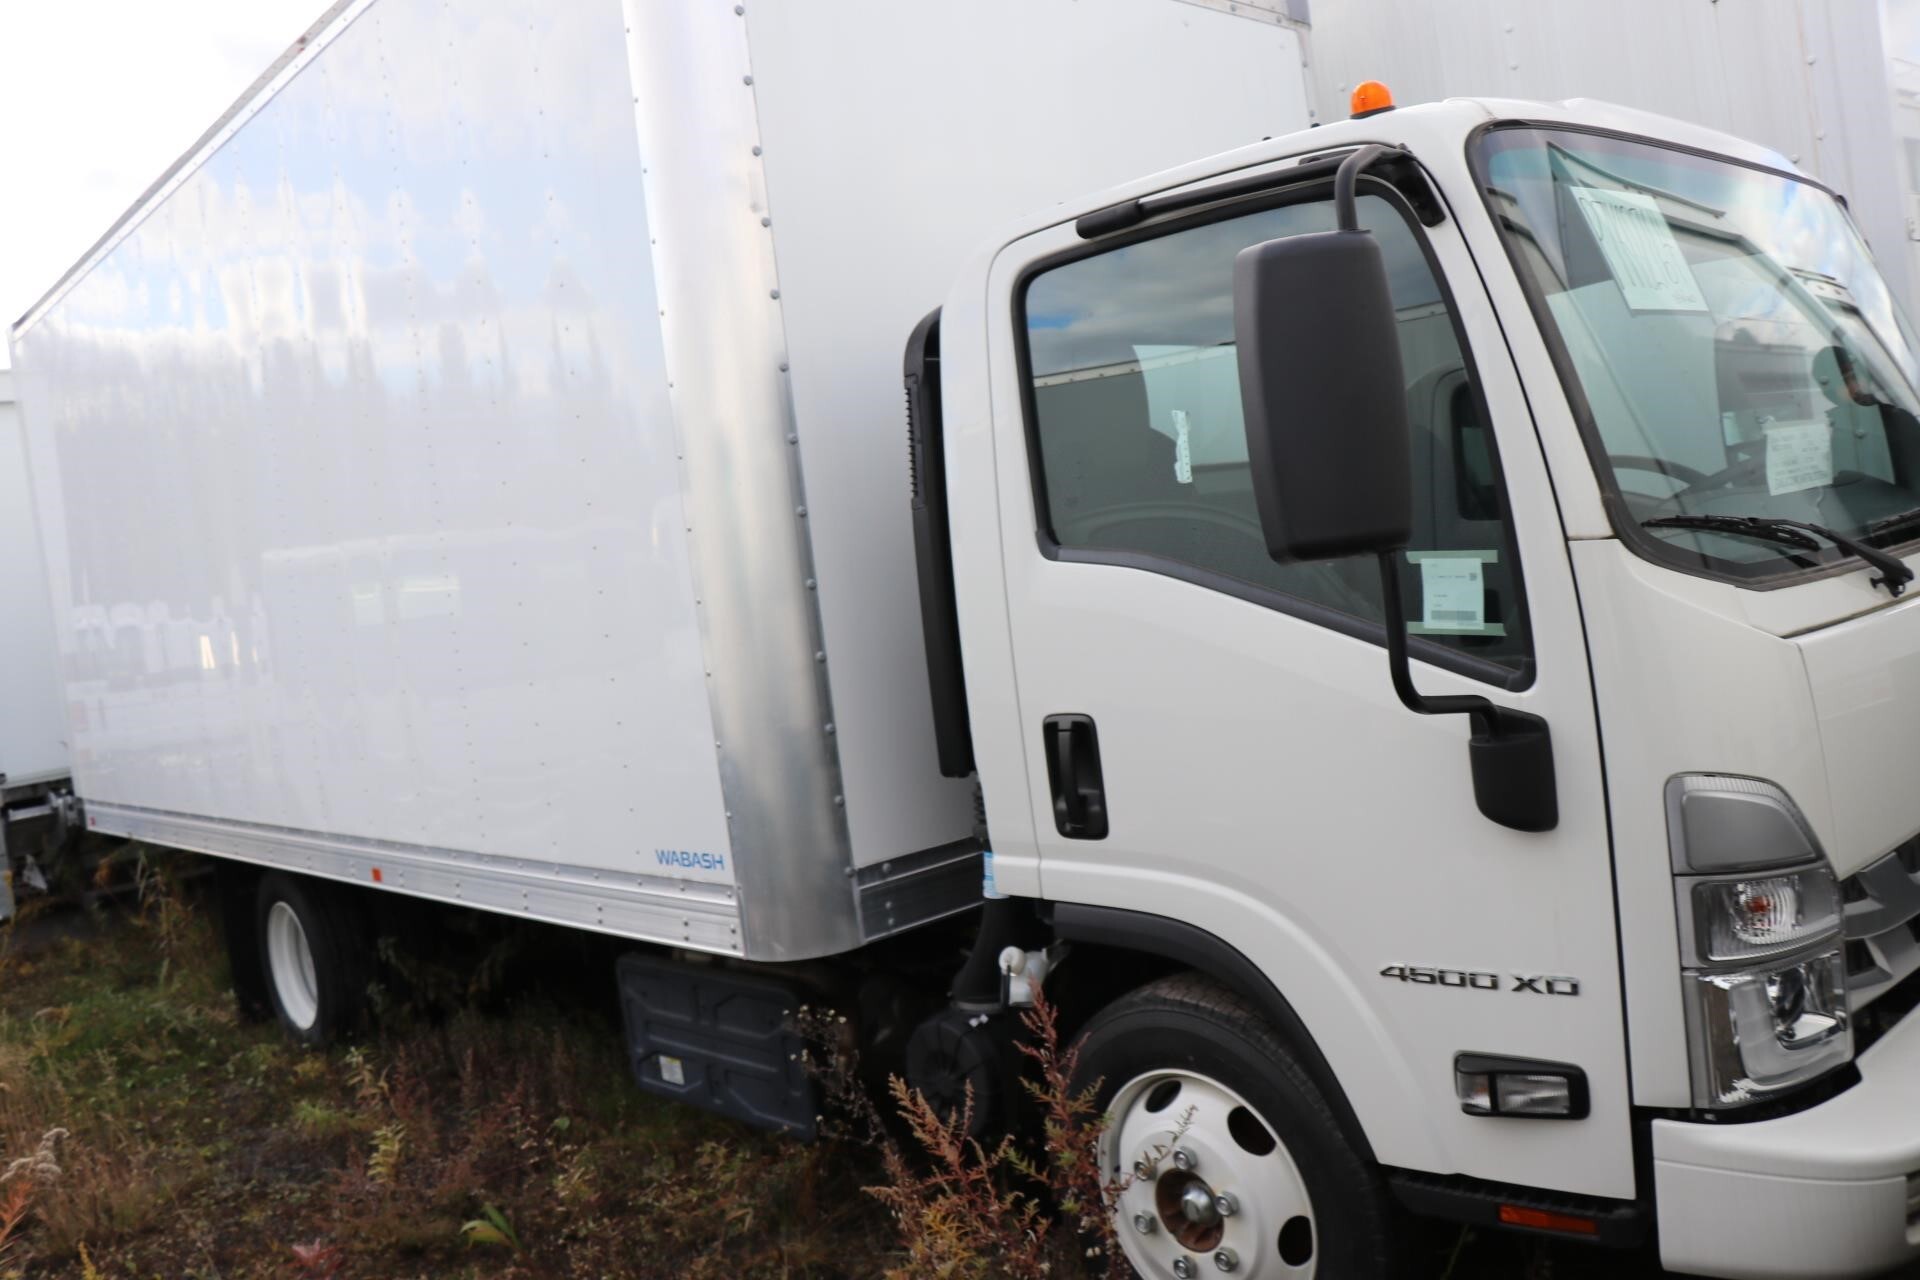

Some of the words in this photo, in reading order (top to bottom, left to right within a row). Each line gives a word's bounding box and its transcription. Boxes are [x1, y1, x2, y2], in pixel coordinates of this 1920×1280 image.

[655, 849, 725, 871] WABASH
[1379, 963, 1500, 990] 4500
[1510, 973, 1580, 997] XD
